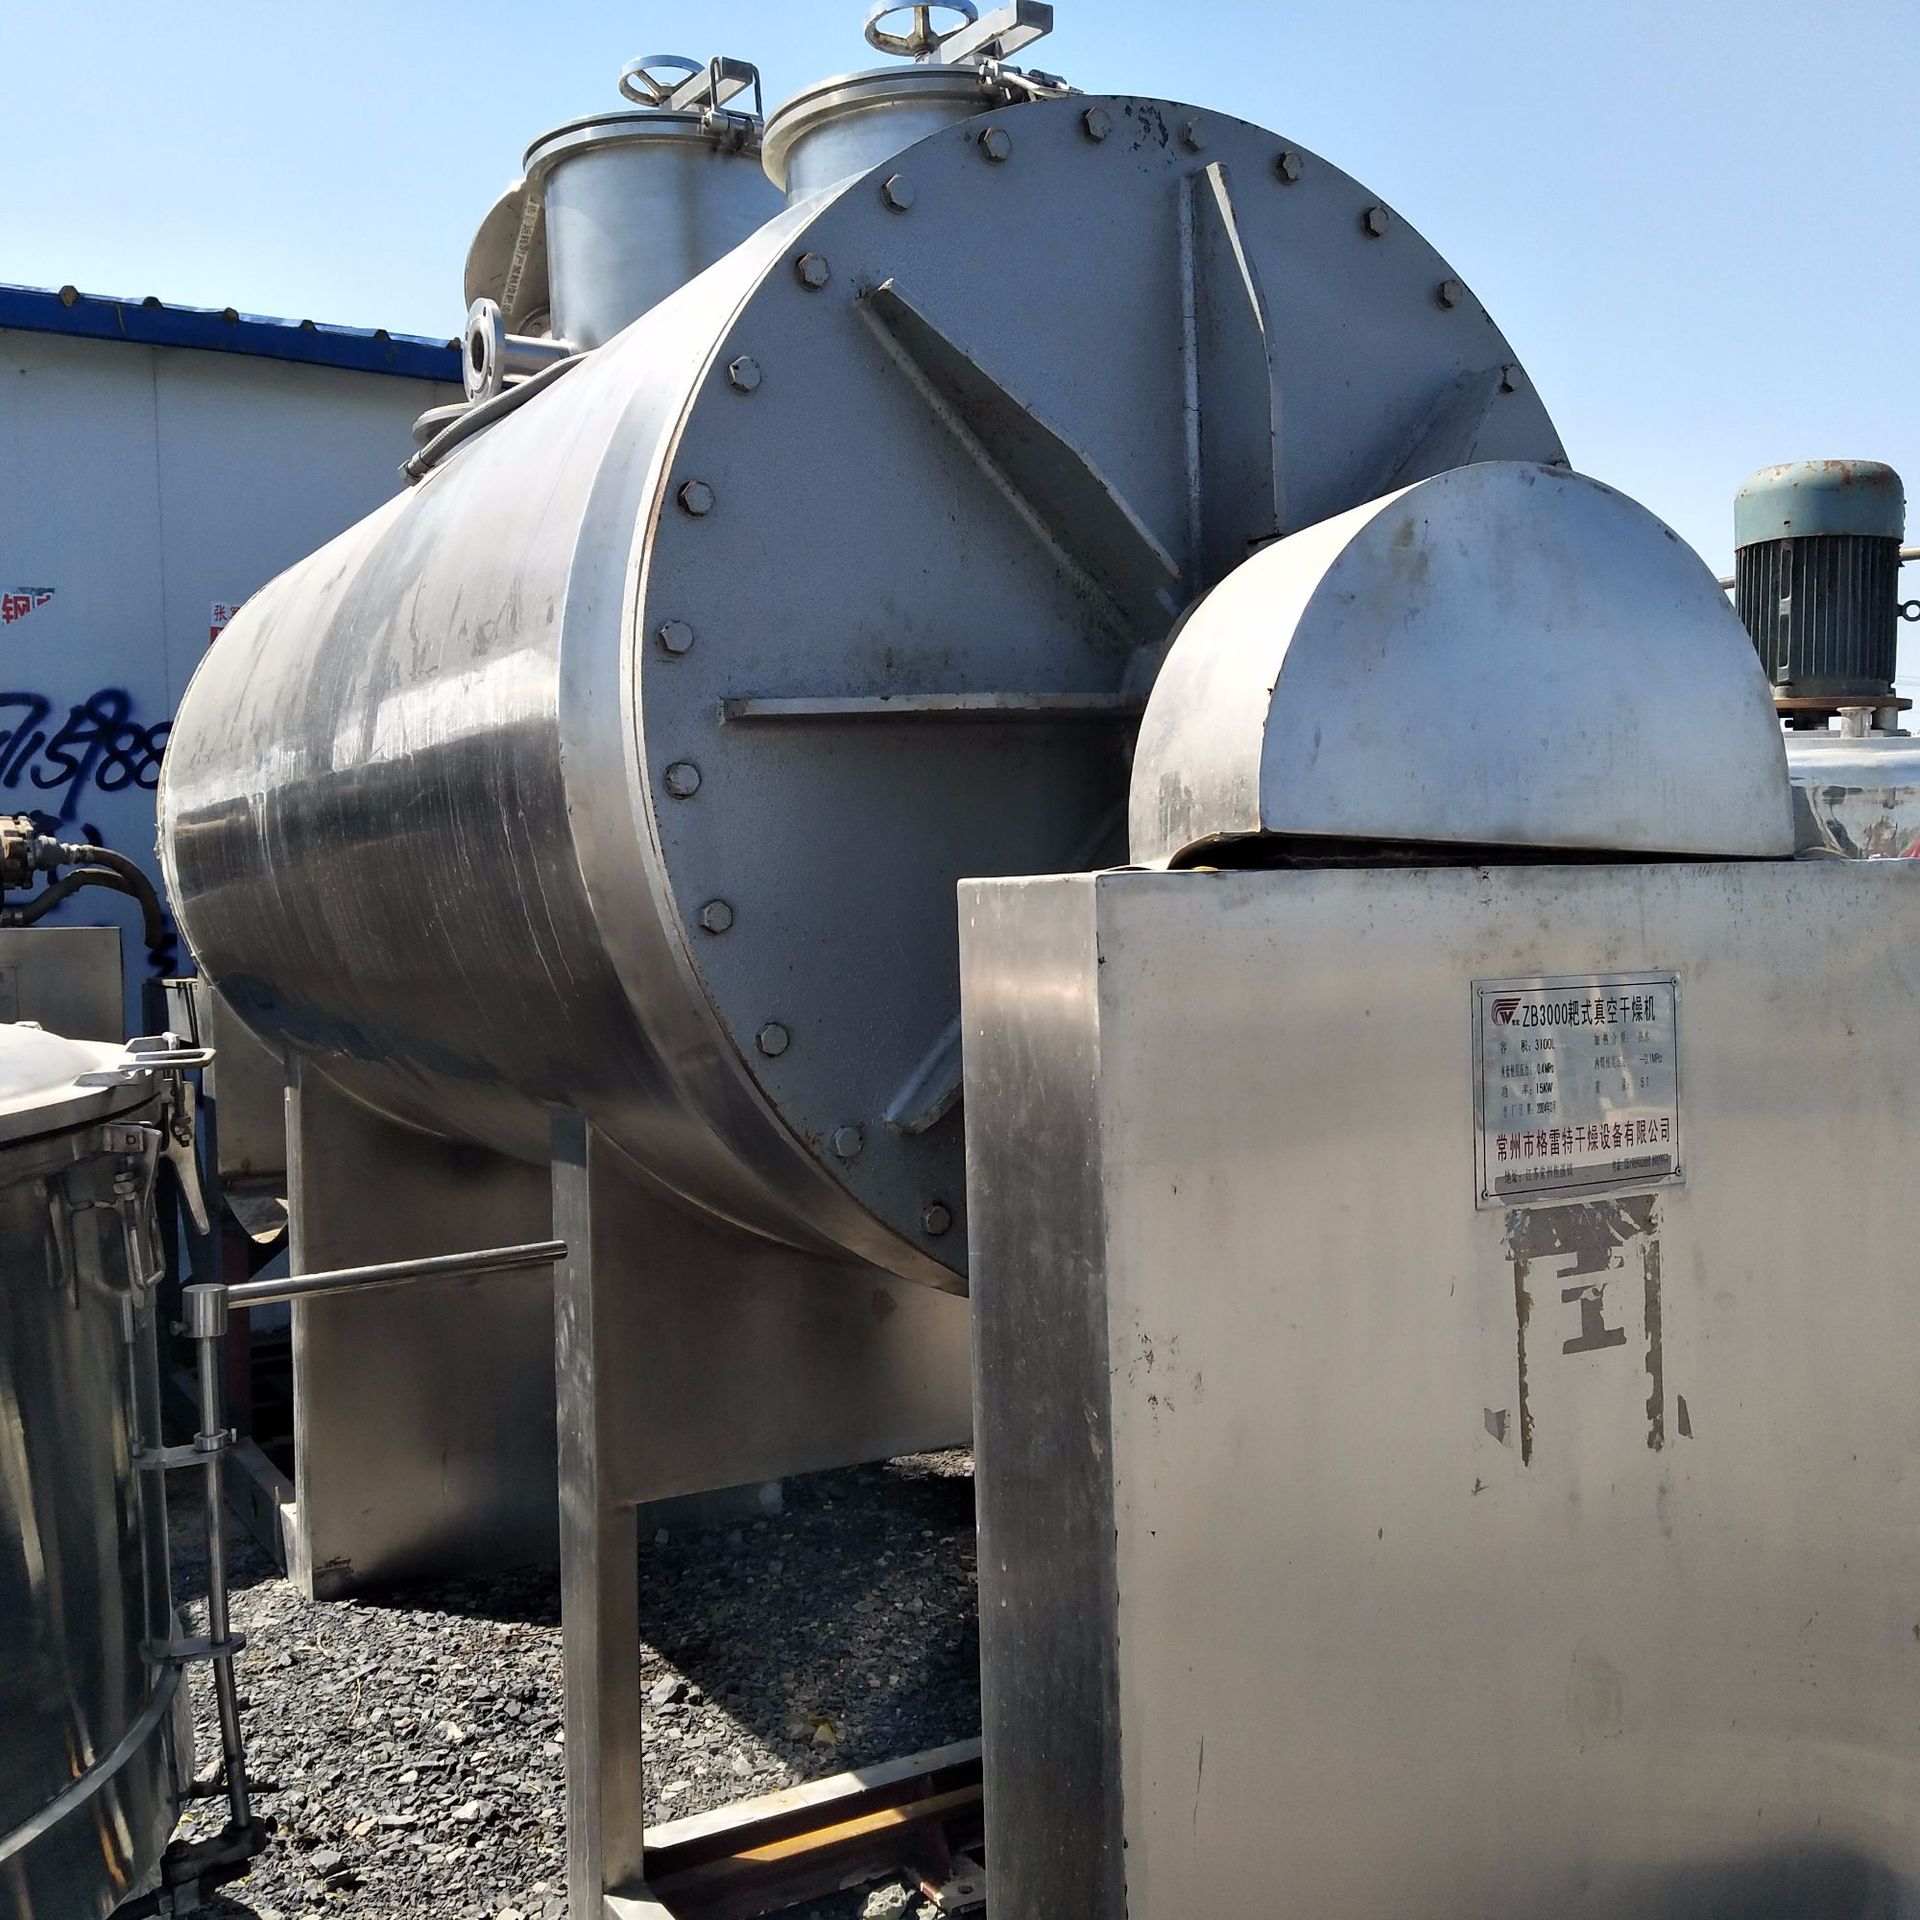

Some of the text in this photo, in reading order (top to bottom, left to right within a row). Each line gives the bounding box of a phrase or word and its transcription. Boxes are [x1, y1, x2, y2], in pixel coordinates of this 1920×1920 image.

[1522, 995, 1656, 1028] ZB3000耙式真空干燥机
[1496, 1117, 1671, 1162] 常州市格雷特干燥设备有限公司
